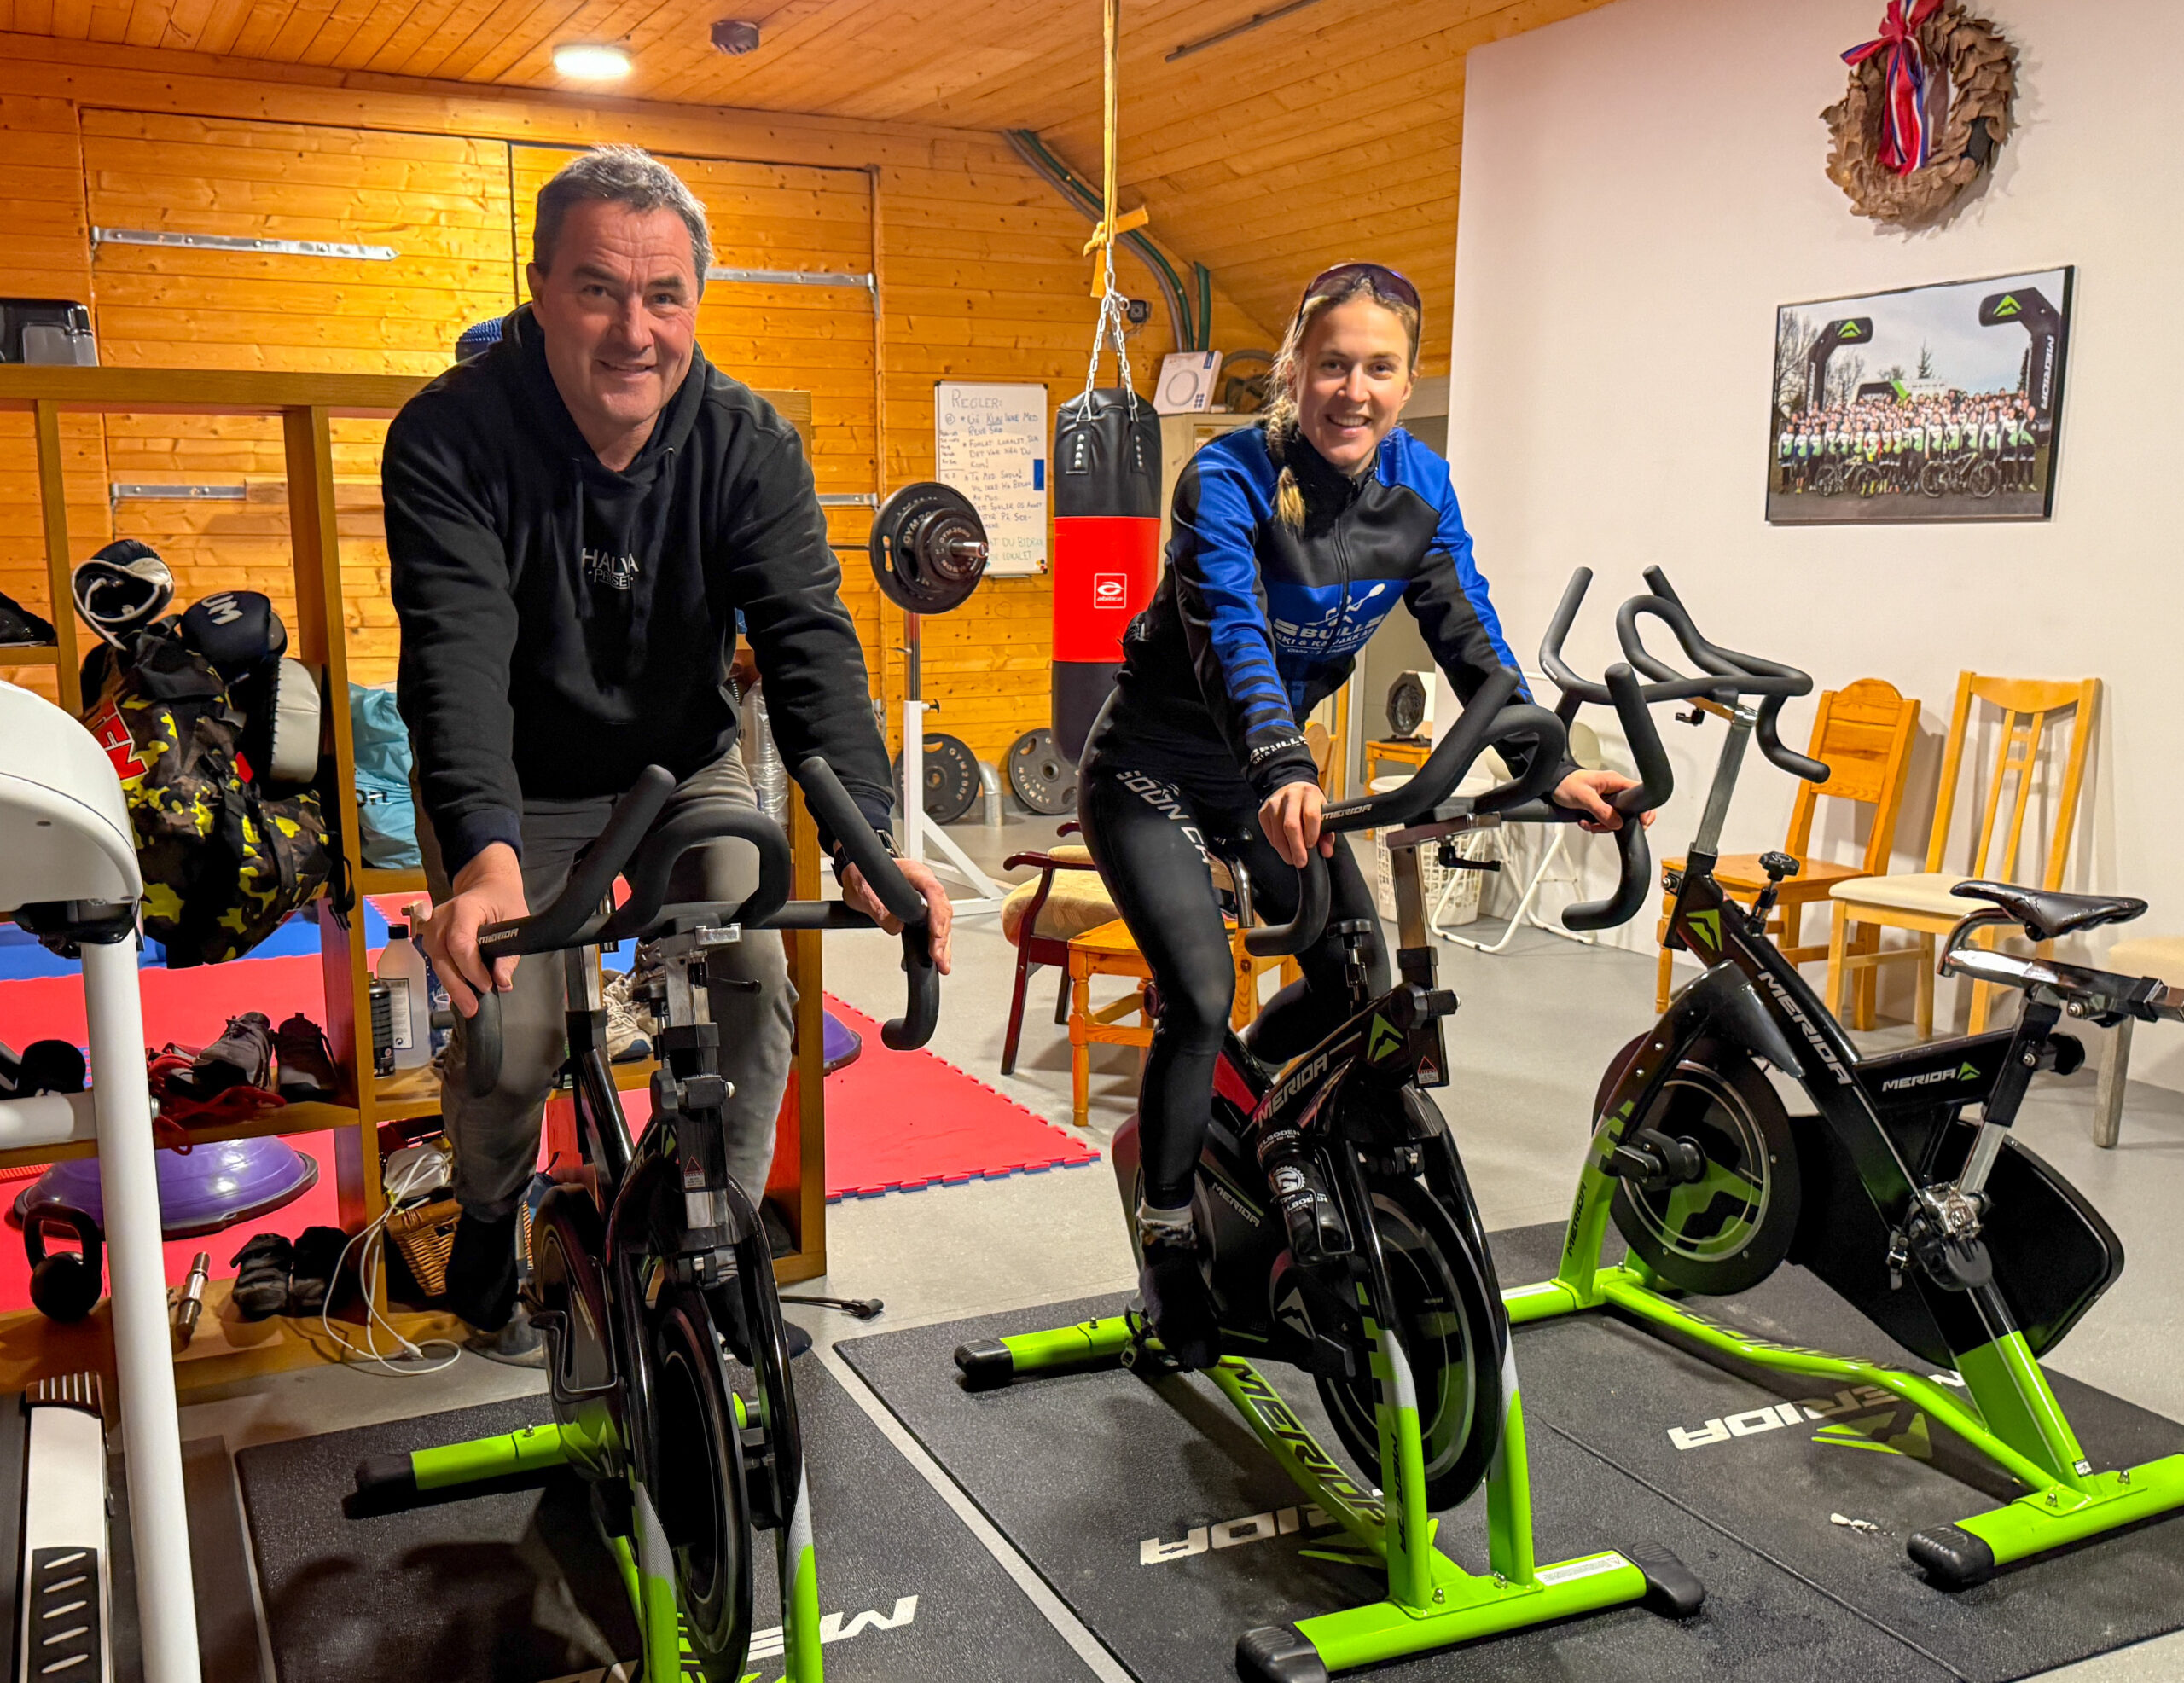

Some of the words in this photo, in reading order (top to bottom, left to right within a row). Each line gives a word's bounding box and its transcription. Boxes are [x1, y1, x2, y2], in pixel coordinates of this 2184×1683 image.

[951, 388, 1002, 409] REGLER:
[1018, 766, 1051, 804] NORWAY
[1322, 804, 1373, 821] MERIDA
[479, 927, 520, 946] MERIDA
[1757, 971, 1852, 1086] MERIDA
[1257, 1053, 1328, 1129] MERIDA
[1881, 1067, 1959, 1093] MERIDA
[1211, 1181, 1261, 1228] MERIDA
[1566, 1180, 1588, 1259] MERIDA
[1390, 1431, 1408, 1556] MERIDA
